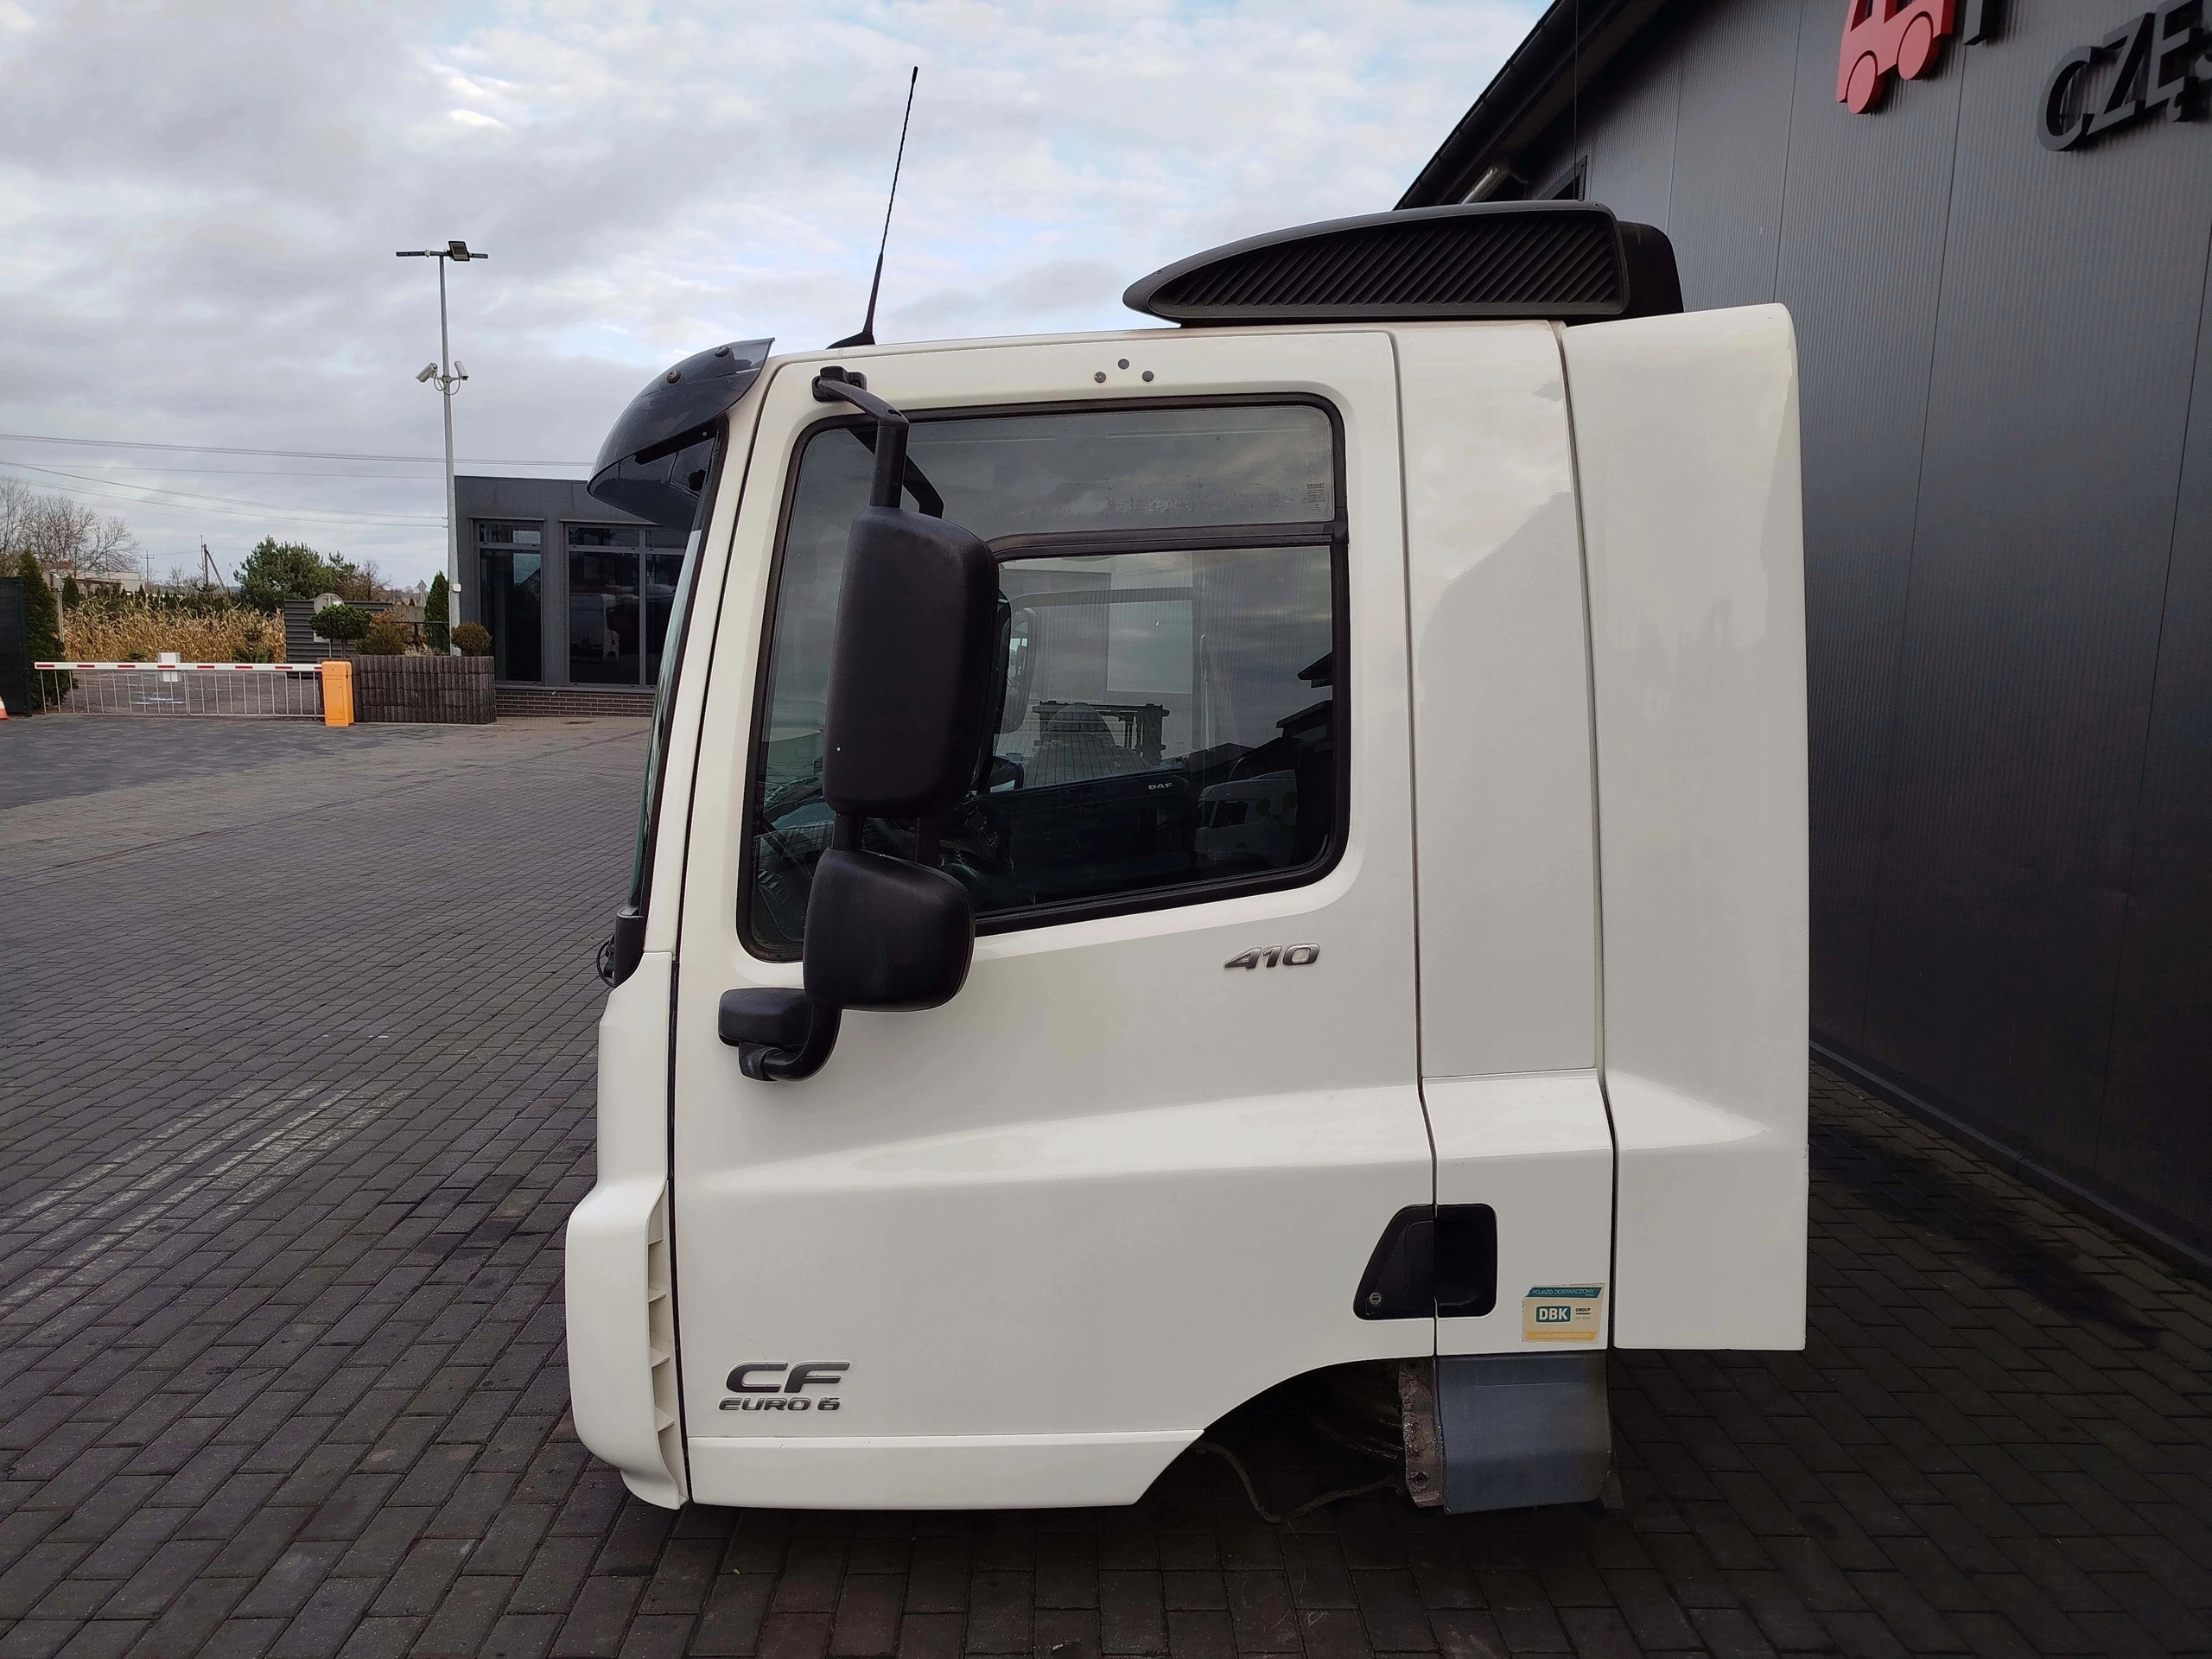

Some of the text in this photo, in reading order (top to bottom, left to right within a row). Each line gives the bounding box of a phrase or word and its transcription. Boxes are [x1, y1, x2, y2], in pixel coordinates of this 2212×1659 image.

[1224, 943, 1320, 969] 410
[1539, 1307, 1568, 1320] DBK
[726, 1361, 851, 1393] CF
[718, 1396, 841, 1411] EURO 6
